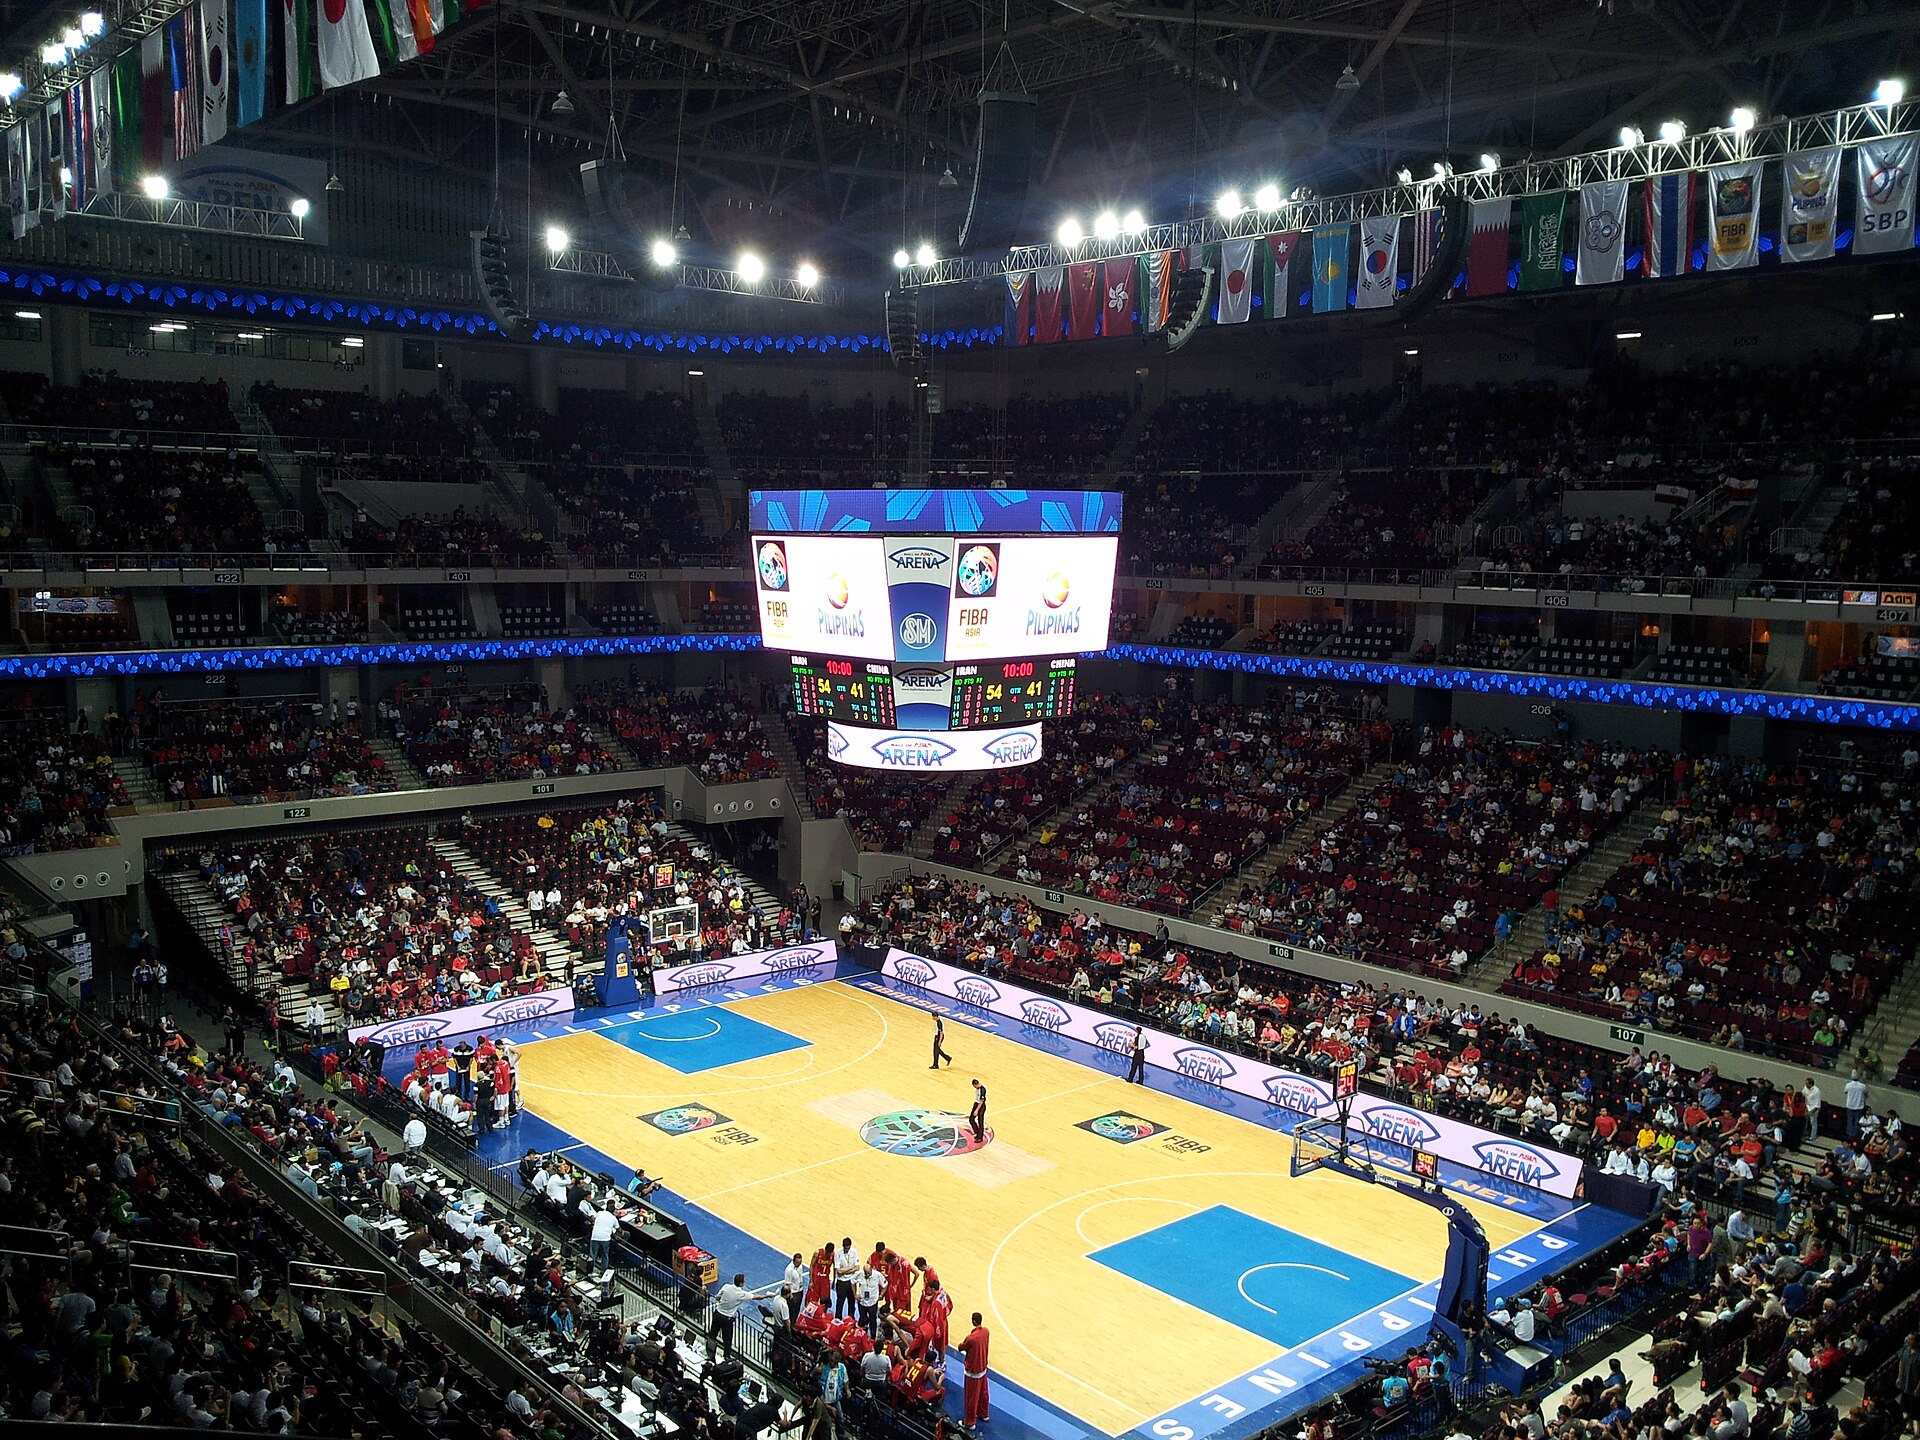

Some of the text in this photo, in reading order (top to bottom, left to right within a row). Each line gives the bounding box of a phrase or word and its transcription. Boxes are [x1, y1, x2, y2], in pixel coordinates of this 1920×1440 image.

[208, 178, 231, 187] MALL
[249, 182, 278, 192] ASIA
[1792, 195, 1826, 209] PILIPINAS
[1863, 210, 1907, 232] SBP
[1721, 223, 1746, 237] FIBA
[896, 557, 941, 570] ARENA
[217, 574, 238, 583] 422
[451, 573, 469, 581] 401
[629, 571, 646, 579] 402
[1147, 580, 1162, 588] 404
[1306, 586, 1323, 595] 405
[1546, 596, 1567, 606] 406
[766, 600, 788, 618] FIBA
[1880, 610, 1906, 621] 407
[818, 608, 865, 638] PILIPINAS
[959, 608, 989, 626] FIBA
[1026, 606, 1081, 636] PILIPINAS
[904, 617, 931, 644] SM
[965, 628, 981, 637] ASIA
[446, 665, 463, 673] 201
[826, 660, 852, 676] 10:00
[866, 664, 889, 675] CHINA
[956, 666, 977, 676] IRAN
[1004, 662, 1033, 678] 10:00
[1050, 659, 1075, 669] CHINA
[205, 675, 226, 684] 222
[818, 678, 832, 694] 54
[902, 676, 942, 688] ARENA
[850, 682, 864, 699] 41
[986, 684, 1003, 700] 54
[1027, 681, 1042, 696] 41
[1531, 705, 1551, 715] 206
[994, 714, 999, 722] 3
[882, 750, 943, 766] ARENA
[993, 744, 1033, 764] ARENA
[536, 785, 550, 793] 101
[289, 809, 306, 818] 122
[657, 874, 672, 886] 24
[1050, 893, 1061, 902] 105
[1275, 947, 1289, 958] 106
[771, 954, 816, 971] ARENA
[679, 970, 726, 988] ARENA
[895, 965, 928, 987] ARENA
[956, 985, 991, 1008] ARENA
[495, 1004, 548, 1024] ARENA
[1022, 1007, 1061, 1032] ARENA
[381, 1026, 440, 1046] ARENA
[1616, 1028, 1636, 1041] 107
[1096, 1031, 1136, 1054] AREN
[1207, 1057, 1221, 1065] ASIA
[1177, 1057, 1223, 1085] ARENA
[1300, 1086, 1315, 1094] ASIA
[1337, 1076, 1354, 1097] 24
[1267, 1086, 1318, 1115] ARENA
[1382, 1112, 1395, 1120] MALL
[1404, 1118, 1421, 1127] ASIA
[716, 1127, 759, 1146] FIBA
[1368, 1117, 1424, 1149] ARENA
[1163, 1135, 1212, 1154] FIBA
[1519, 1153, 1538, 1163] ASIA
[1416, 1161, 1432, 1176] 24
[1479, 1152, 1541, 1187] ARENA
[907, 1366, 920, 1382] 14
